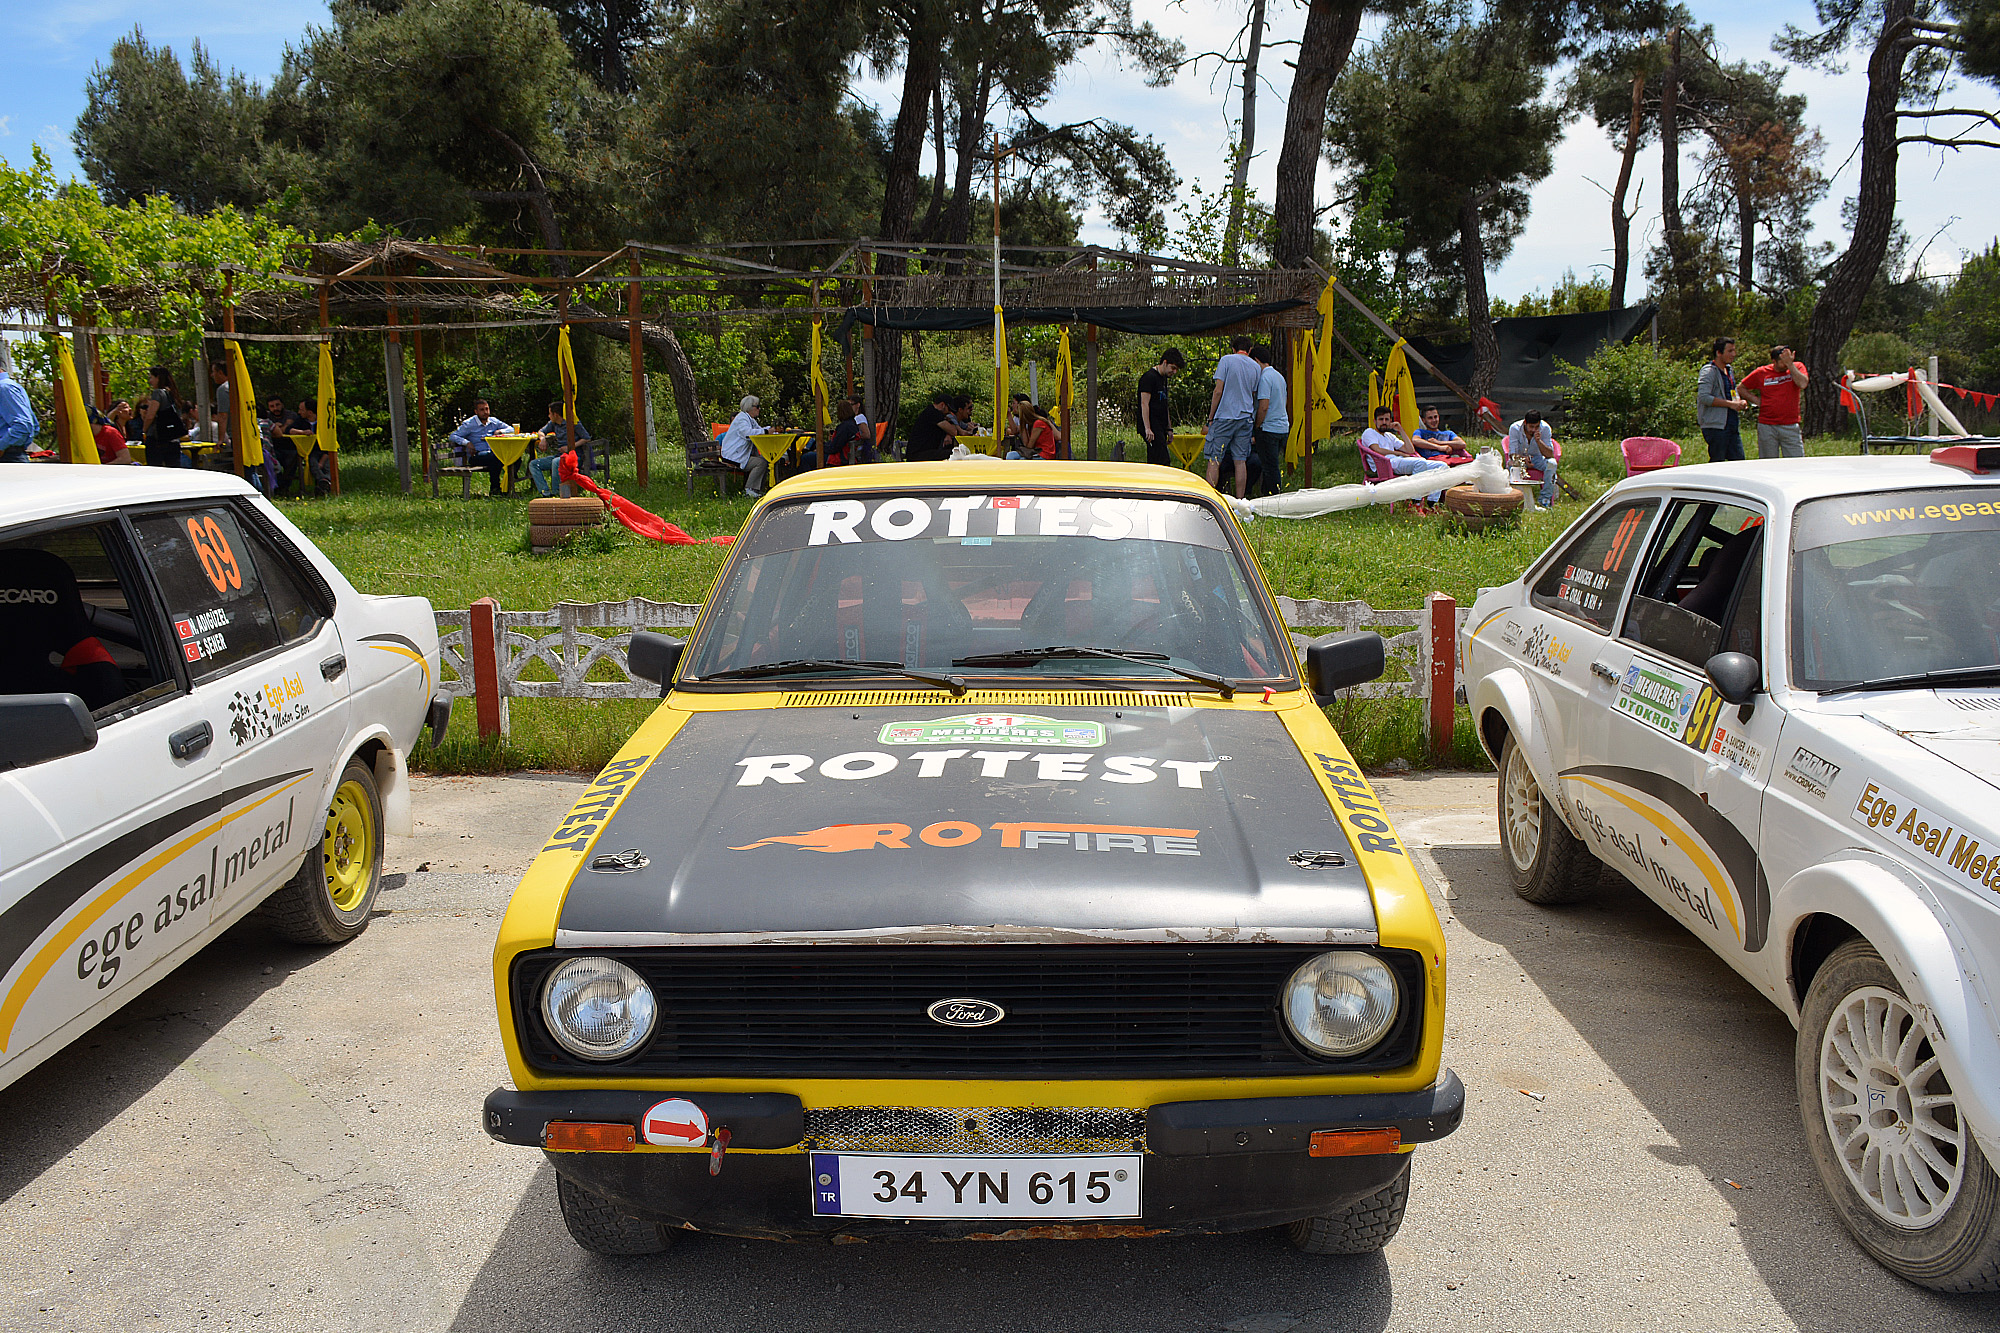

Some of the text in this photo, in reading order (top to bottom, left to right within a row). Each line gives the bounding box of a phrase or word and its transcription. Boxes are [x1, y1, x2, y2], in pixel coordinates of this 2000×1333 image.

[804, 495, 1180, 546] ROTTEST
[1602, 508, 1645, 572] 91
[187, 516, 242, 593] 69
[264, 671, 305, 712] Ege Asal
[1633, 675, 1681, 710] MENDERES
[272, 704, 310, 730] Motor Spor
[931, 727, 1055, 737] MENDERES
[974, 717, 1014, 726] 81
[1619, 697, 1680, 734] OTOKROS
[1686, 686, 1722, 750] 91
[734, 751, 1220, 789] ROTTEST
[541, 754, 651, 853] ROTTEST
[1313, 752, 1404, 856] ROTTEST
[1856, 782, 1897, 828] Ege
[1896, 807, 1953, 858] Asal
[1575, 799, 1720, 931] ege asal metal
[77, 796, 294, 990] ege asal metal
[946, 1002, 986, 1022] Ford
[820, 1191, 836, 1203] TR
[872, 1170, 1111, 1205] 34 YN 615
